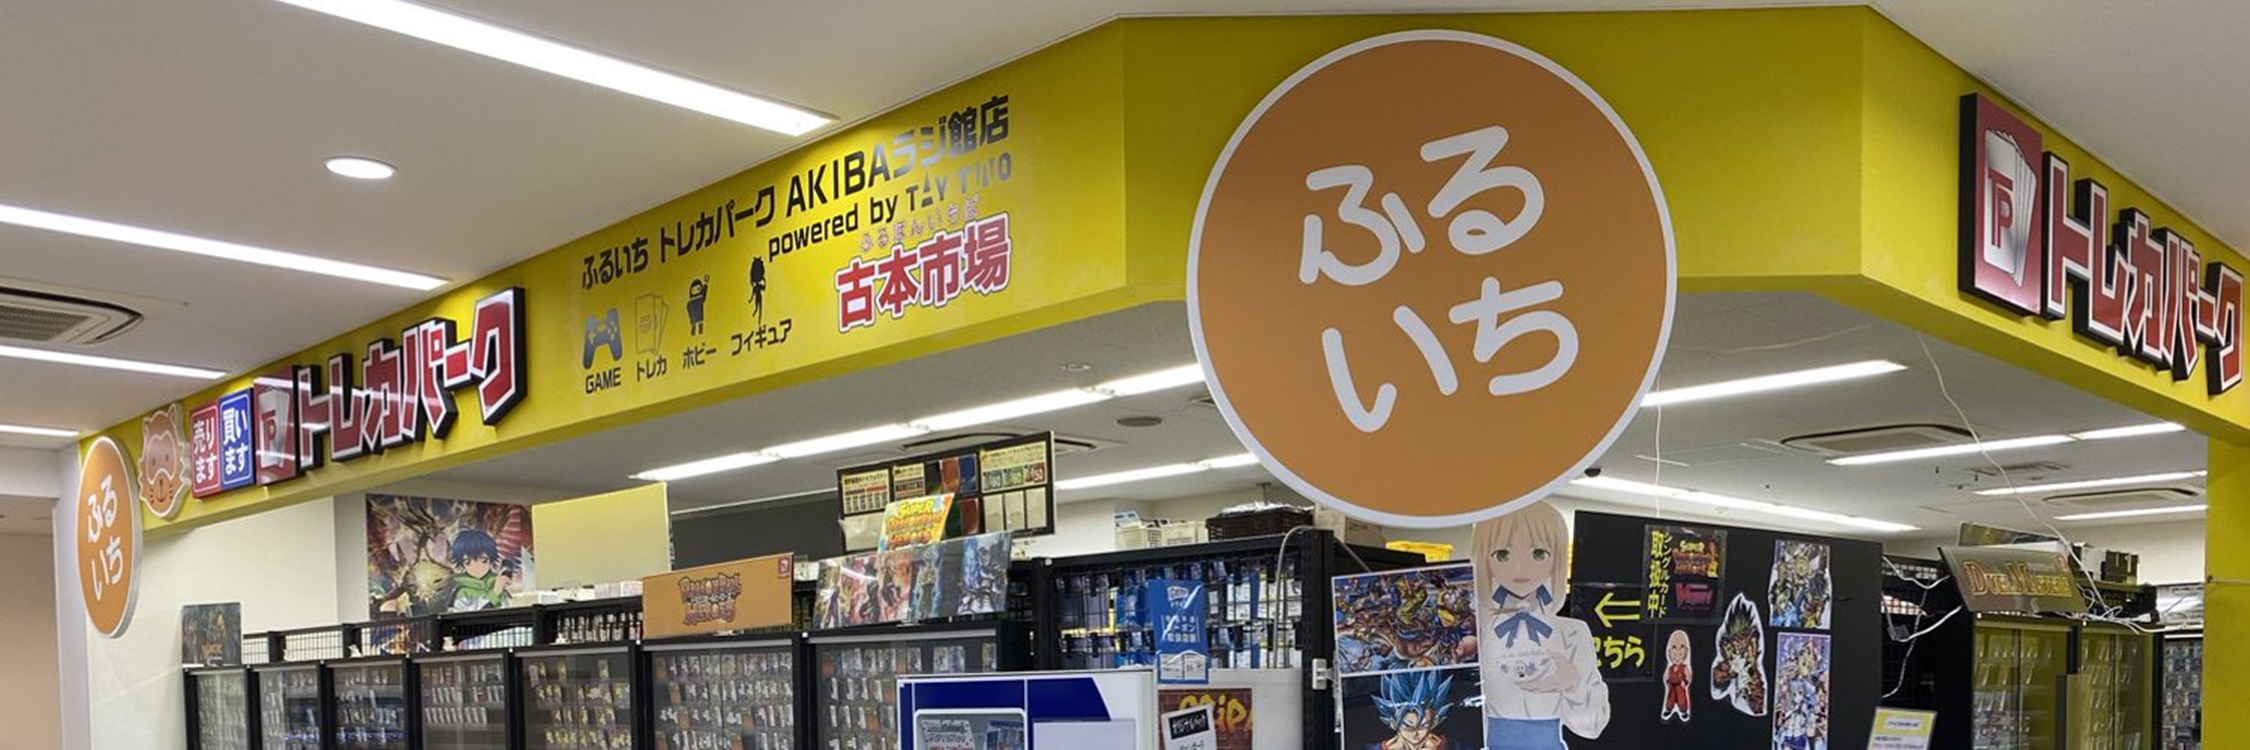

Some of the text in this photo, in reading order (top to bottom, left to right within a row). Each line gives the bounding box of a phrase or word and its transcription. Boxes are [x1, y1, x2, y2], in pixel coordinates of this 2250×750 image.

[582, 237, 649, 290] ふるいち
[660, 185, 776, 264] トレカパーク
[768, 203, 859, 263] powered
[870, 195, 898, 225] by
[1299, 125, 1545, 286] ふる
[836, 212, 1011, 333] 古本市場
[2045, 151, 2244, 396] トレカパーク
[636, 355, 668, 382] トレカ
[682, 343, 717, 369] ホビー
[731, 318, 792, 356] フィギュア
[1322, 276, 1579, 432] いち
[299, 286, 527, 470] トレカパーク
[585, 367, 622, 394] GAME
[193, 416, 215, 454] 売り
[222, 407, 248, 445] 買い
[224, 442, 249, 475] ます
[195, 452, 217, 483] ます
[88, 475, 118, 543] ふる
[91, 535, 124, 601] いち
